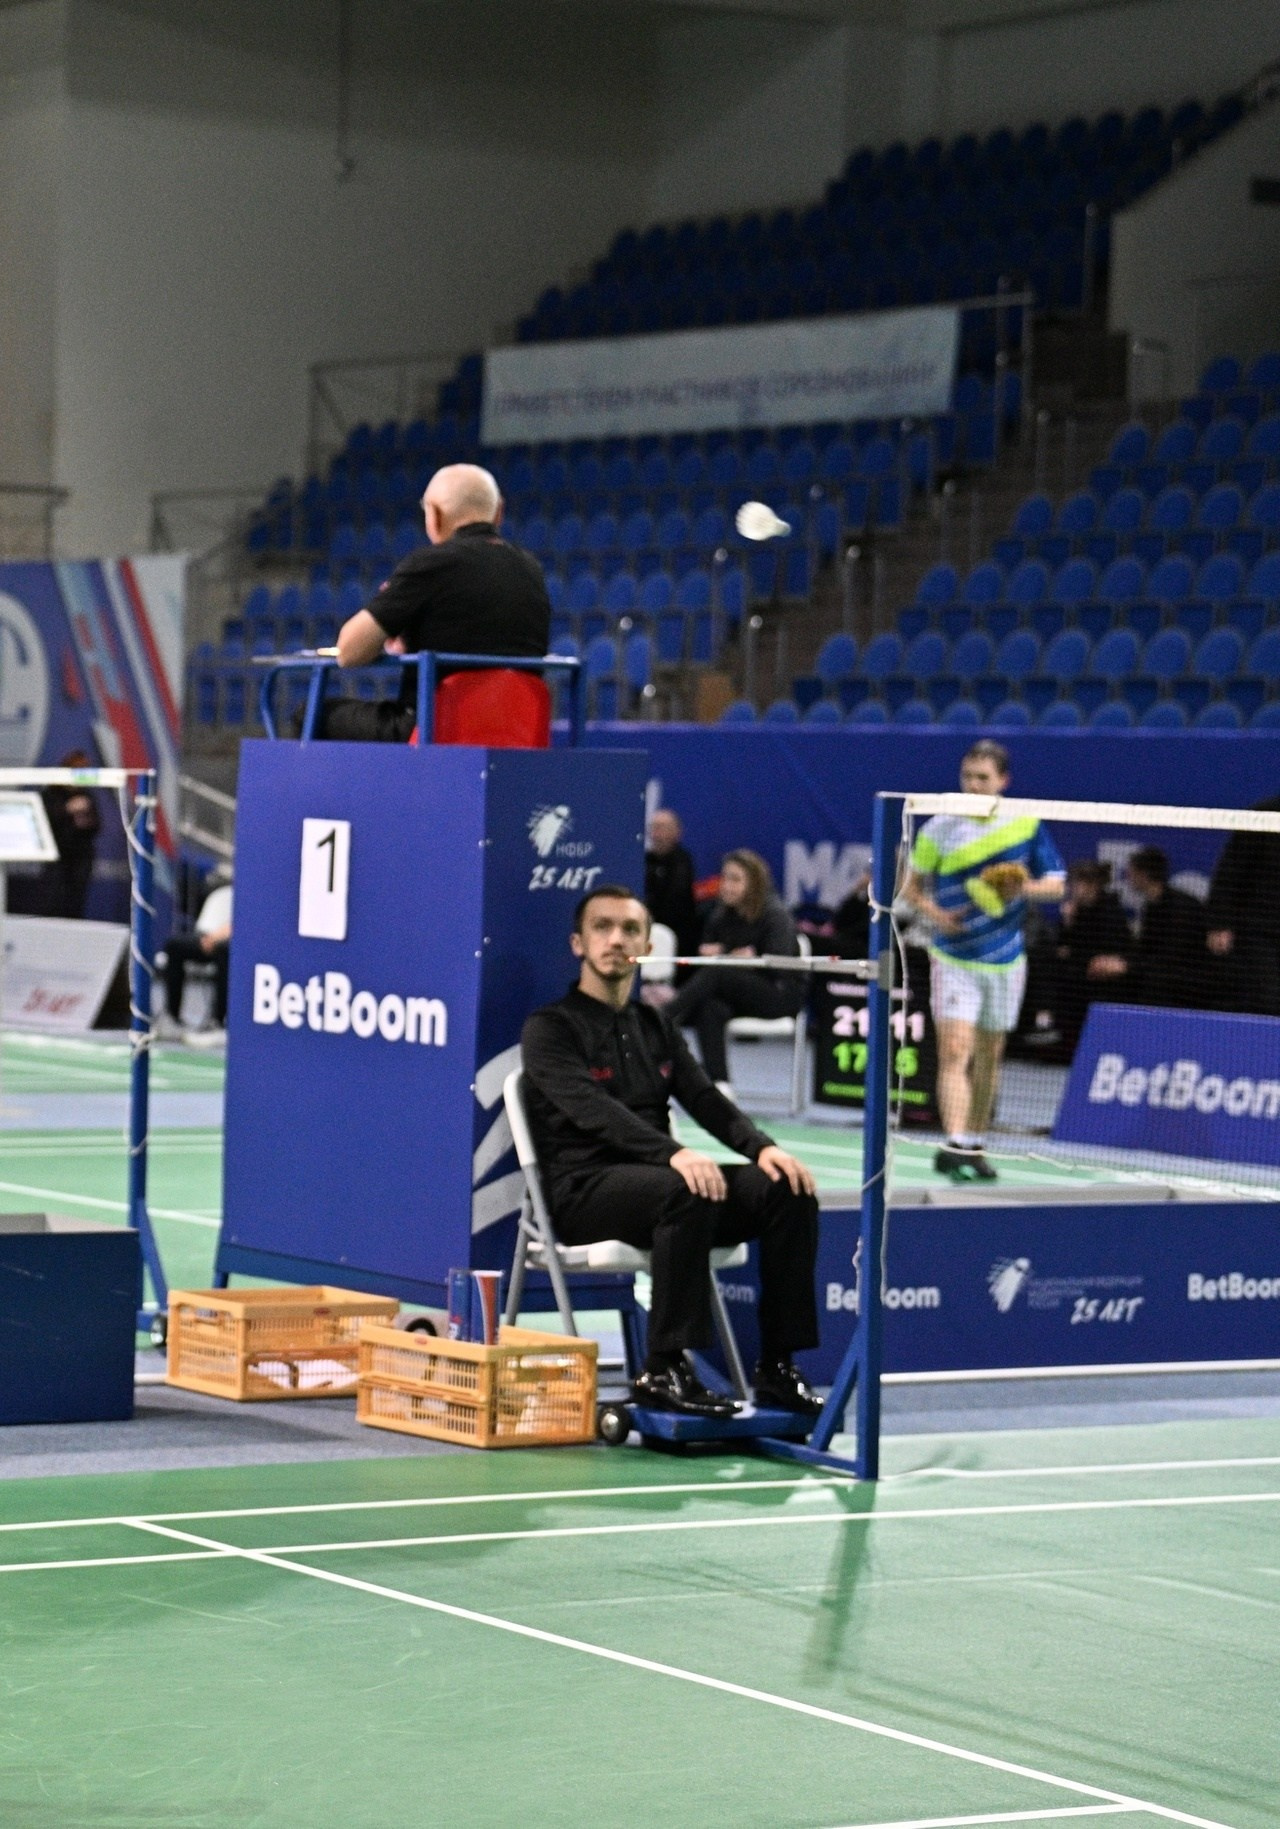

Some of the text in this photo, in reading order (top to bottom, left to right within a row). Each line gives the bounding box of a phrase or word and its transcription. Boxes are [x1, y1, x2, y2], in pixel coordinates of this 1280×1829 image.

[317, 828, 337, 893] 1
[528, 864, 603, 891] 25 ЛЕТ
[253, 963, 448, 1047] BetBoom
[1070, 1296, 1100, 1325] 25
